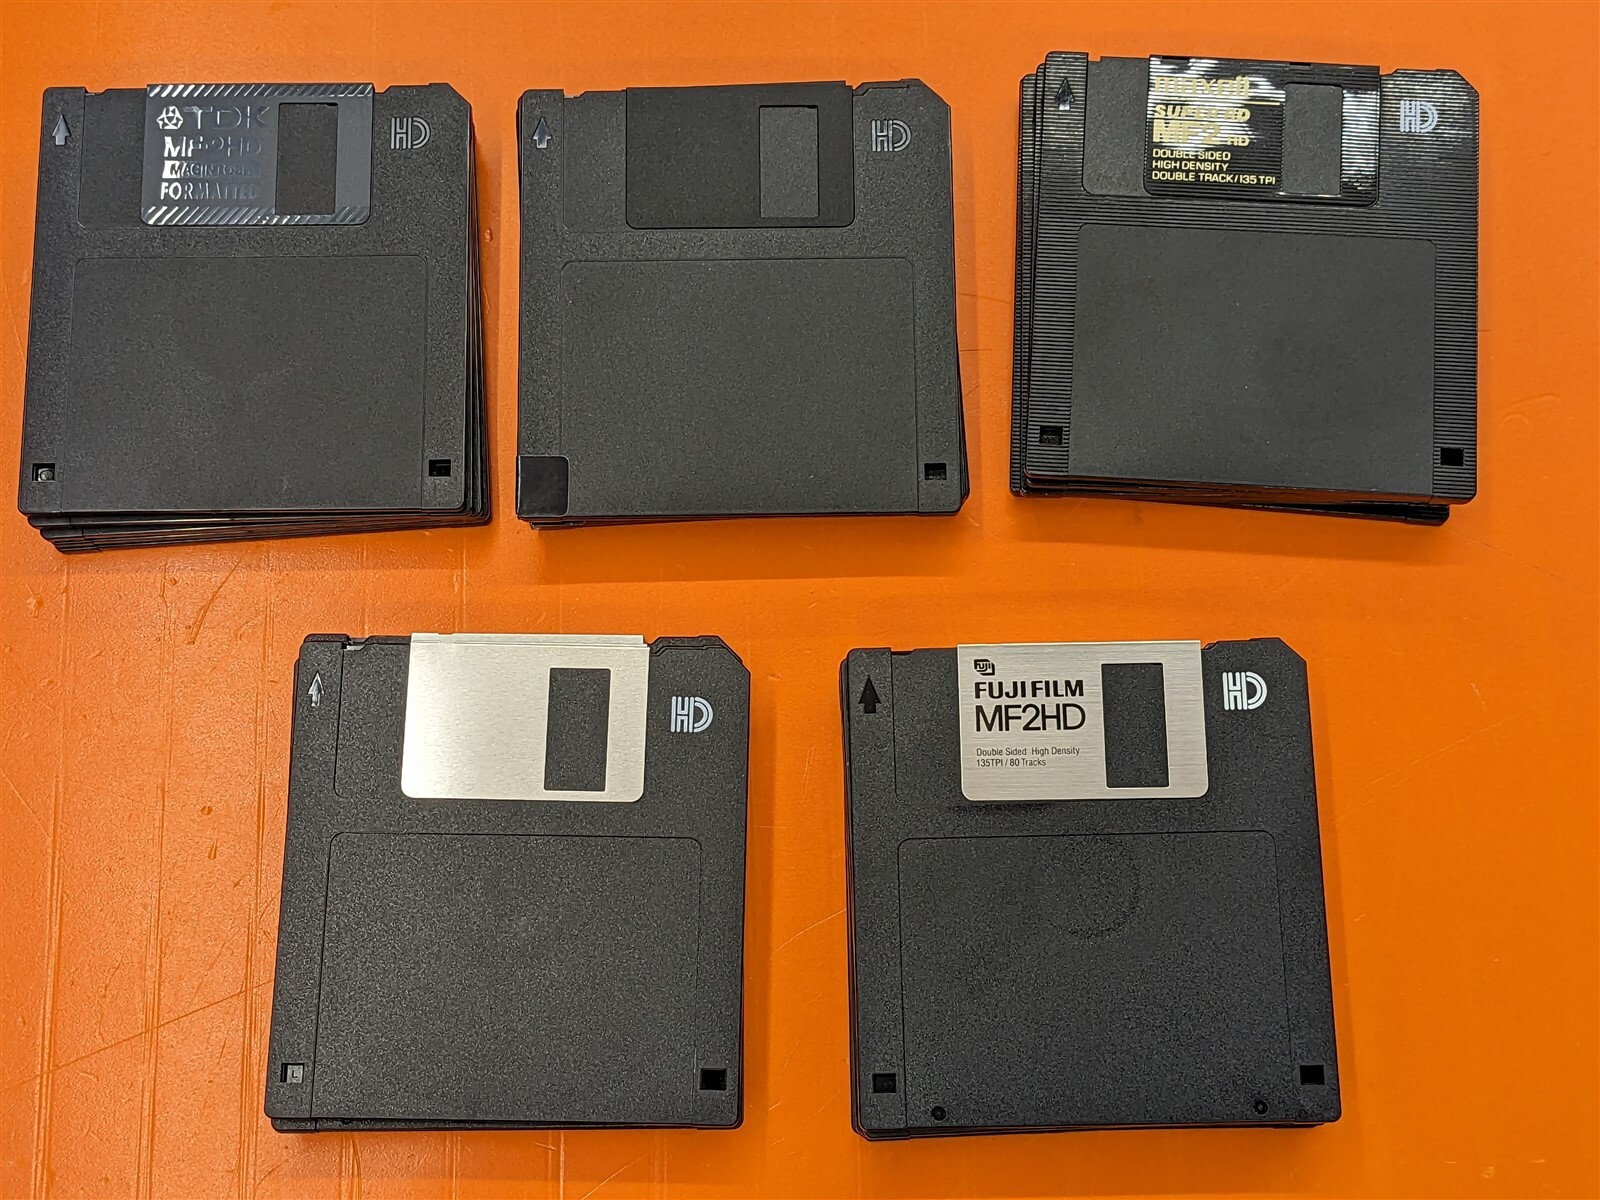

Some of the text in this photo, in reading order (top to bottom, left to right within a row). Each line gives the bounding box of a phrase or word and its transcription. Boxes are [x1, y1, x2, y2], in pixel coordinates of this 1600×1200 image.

[1154, 75, 1250, 98] maxell
[182, 105, 271, 129] TDK
[1154, 104, 1251, 122] SUPER HD
[1400, 99, 1438, 133] HD
[390, 117, 432, 150] HD
[871, 119, 912, 152] HD
[1152, 149, 1231, 161] DOUBLE SIDED
[1152, 160, 1229, 171] HIGH DENSITY
[1152, 171, 1196, 181] DOUBLE
[1259, 175, 1276, 185] TPI
[160, 181, 258, 200] FORMATTED
[1222, 671, 1268, 711] HD
[670, 696, 714, 733] HD
[975, 703, 1087, 732] MF2HD
[976, 746, 1081, 757] Double Sided High Density
[976, 758, 1003, 767] 135TPI
[1009, 758, 1020, 767] 80
[1021, 757, 1047, 767] Tracks
